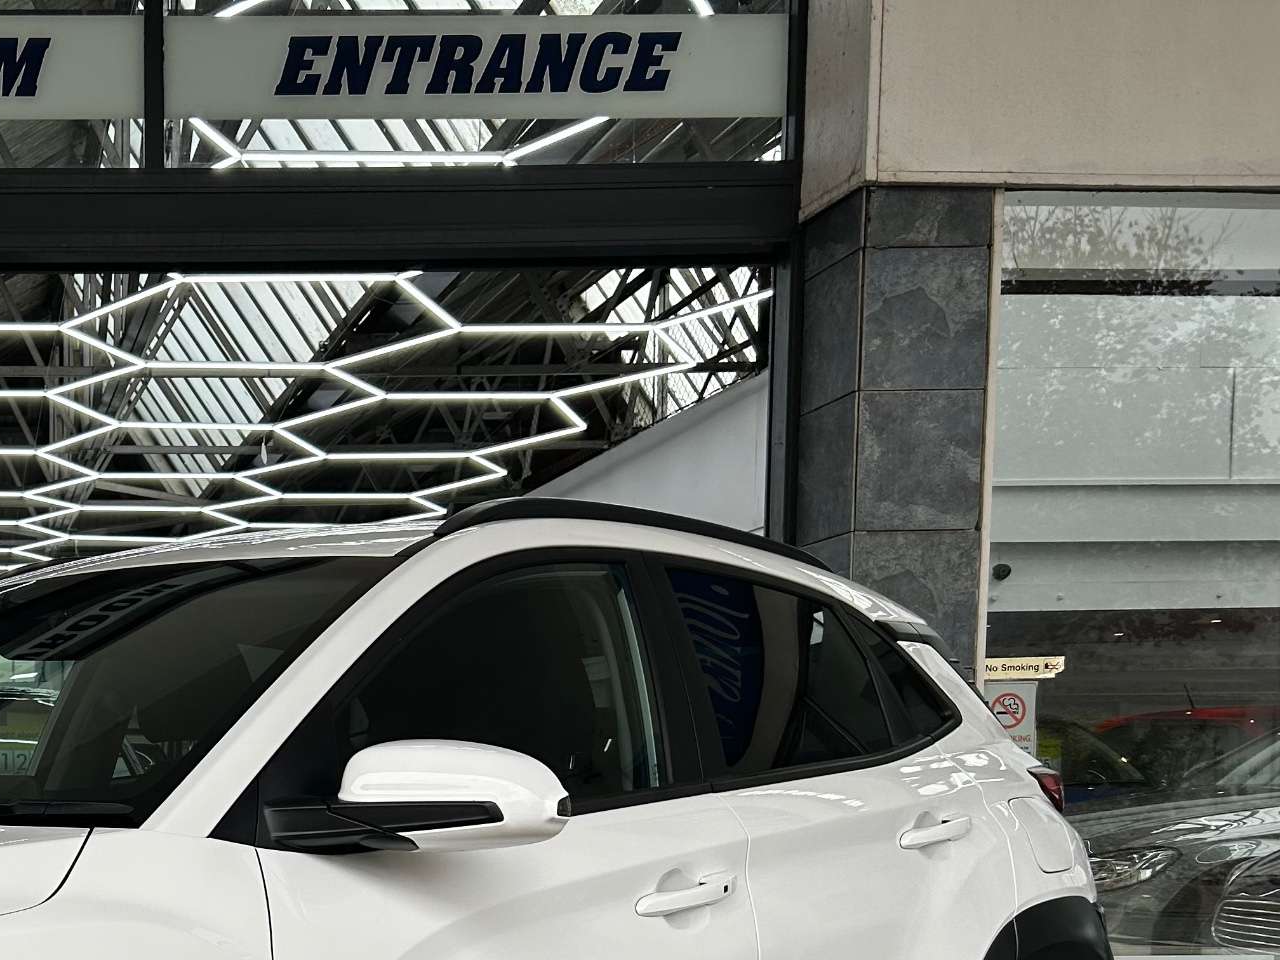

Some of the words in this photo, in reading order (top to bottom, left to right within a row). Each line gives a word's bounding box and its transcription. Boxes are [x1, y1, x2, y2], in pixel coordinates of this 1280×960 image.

[273, 31, 683, 96] ENTRANCE
[985, 664, 998, 672] No
[1001, 663, 1040, 673] Smoking
